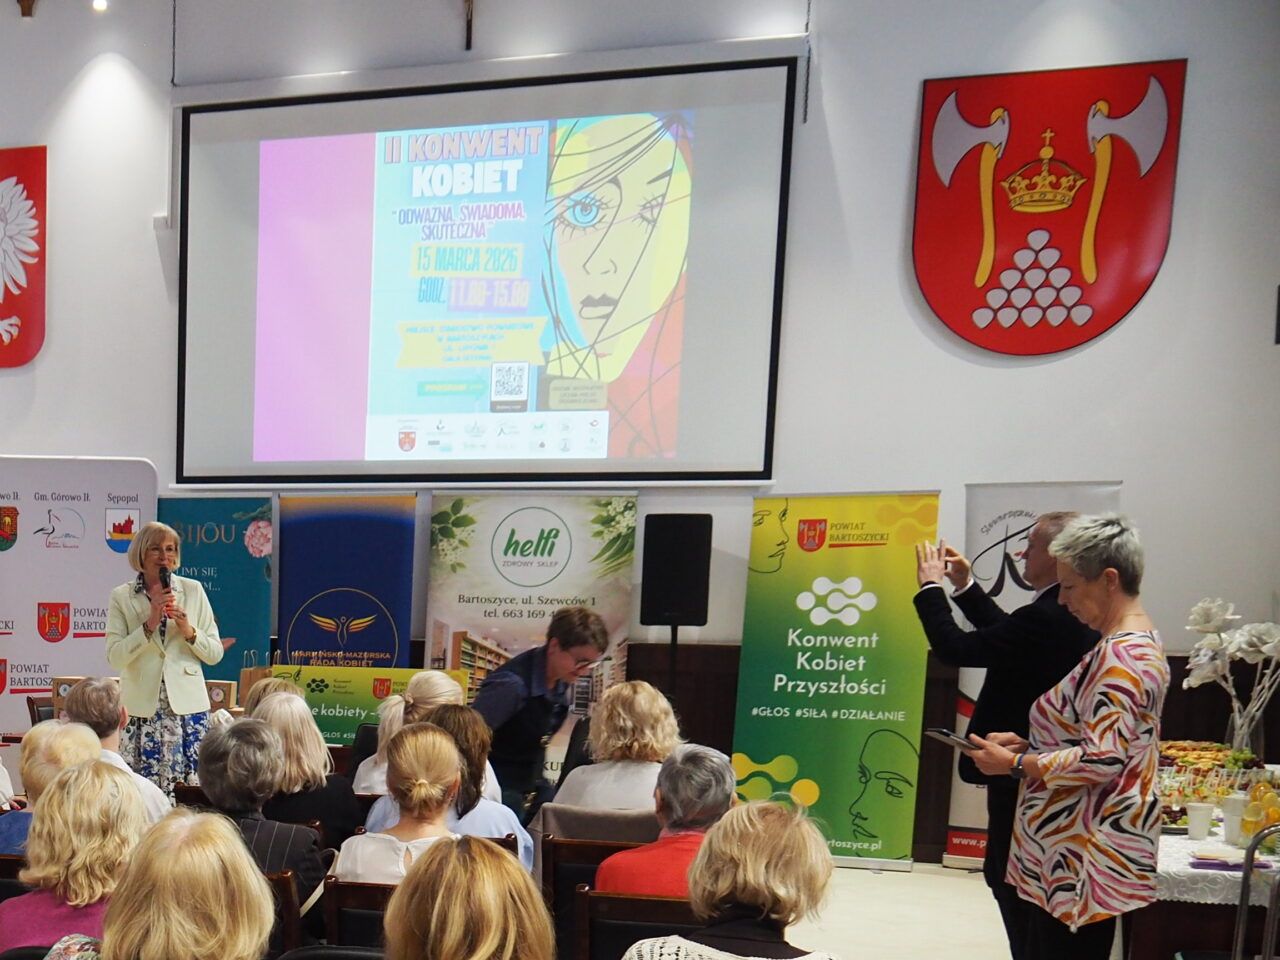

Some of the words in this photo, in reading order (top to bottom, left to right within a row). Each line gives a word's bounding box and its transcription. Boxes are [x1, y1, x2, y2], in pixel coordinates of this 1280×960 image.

[384, 135, 401, 163] II
[408, 126, 543, 162] KONWENT
[412, 159, 523, 197] KOBIET
[434, 246, 480, 271] MARCA
[51, 492, 82, 501] Górowo
[829, 522, 866, 530] POWIAT
[503, 528, 560, 557] helfi
[829, 533, 889, 542] BARTOSZYCKI
[458, 594, 518, 606] Bartoszyce,
[521, 596, 534, 605] ul.
[537, 595, 587, 605] Szewców
[591, 597, 596, 605] 1
[483, 608, 499, 618] tel.
[502, 609, 524, 618] 663
[527, 610, 545, 618] 169
[787, 628, 879, 648] Konwent
[310, 659, 336, 667] RADA
[796, 651, 866, 671] Kobiet
[10, 664, 49, 673] POWIAT
[10, 677, 53, 687] BARTOSZ
[773, 673, 887, 698] Przyszłości
[321, 704, 368, 720] kobiety
[751, 706, 790, 717] #GŁOS
[795, 707, 828, 718] #SIŁA
